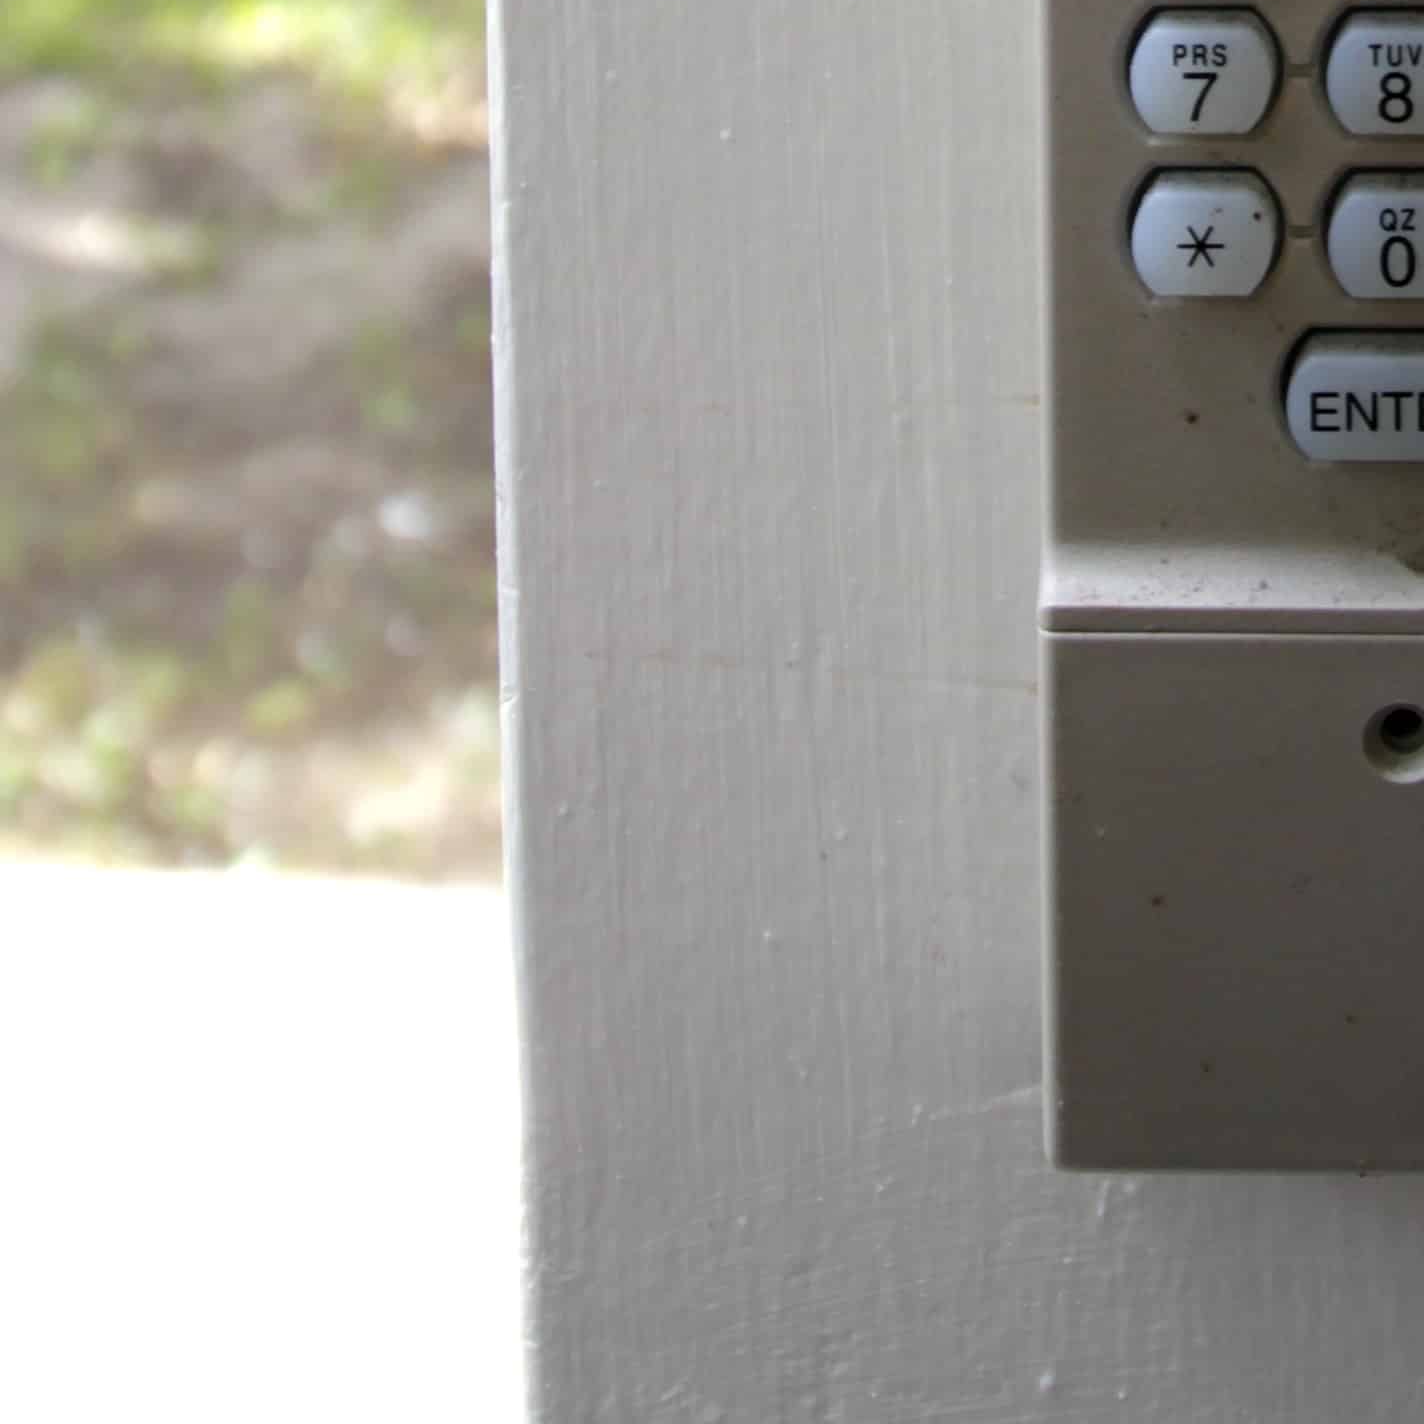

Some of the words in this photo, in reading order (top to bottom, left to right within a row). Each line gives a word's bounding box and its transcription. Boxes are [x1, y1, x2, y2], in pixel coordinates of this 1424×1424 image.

[1173, 43, 1228, 68] PRS
[1368, 43, 1423, 68] TUV
[1183, 71, 1219, 122] 7
[1378, 71, 1414, 124] 8
[1379, 207, 1416, 233] QZ
[1380, 235, 1417, 288] 0
